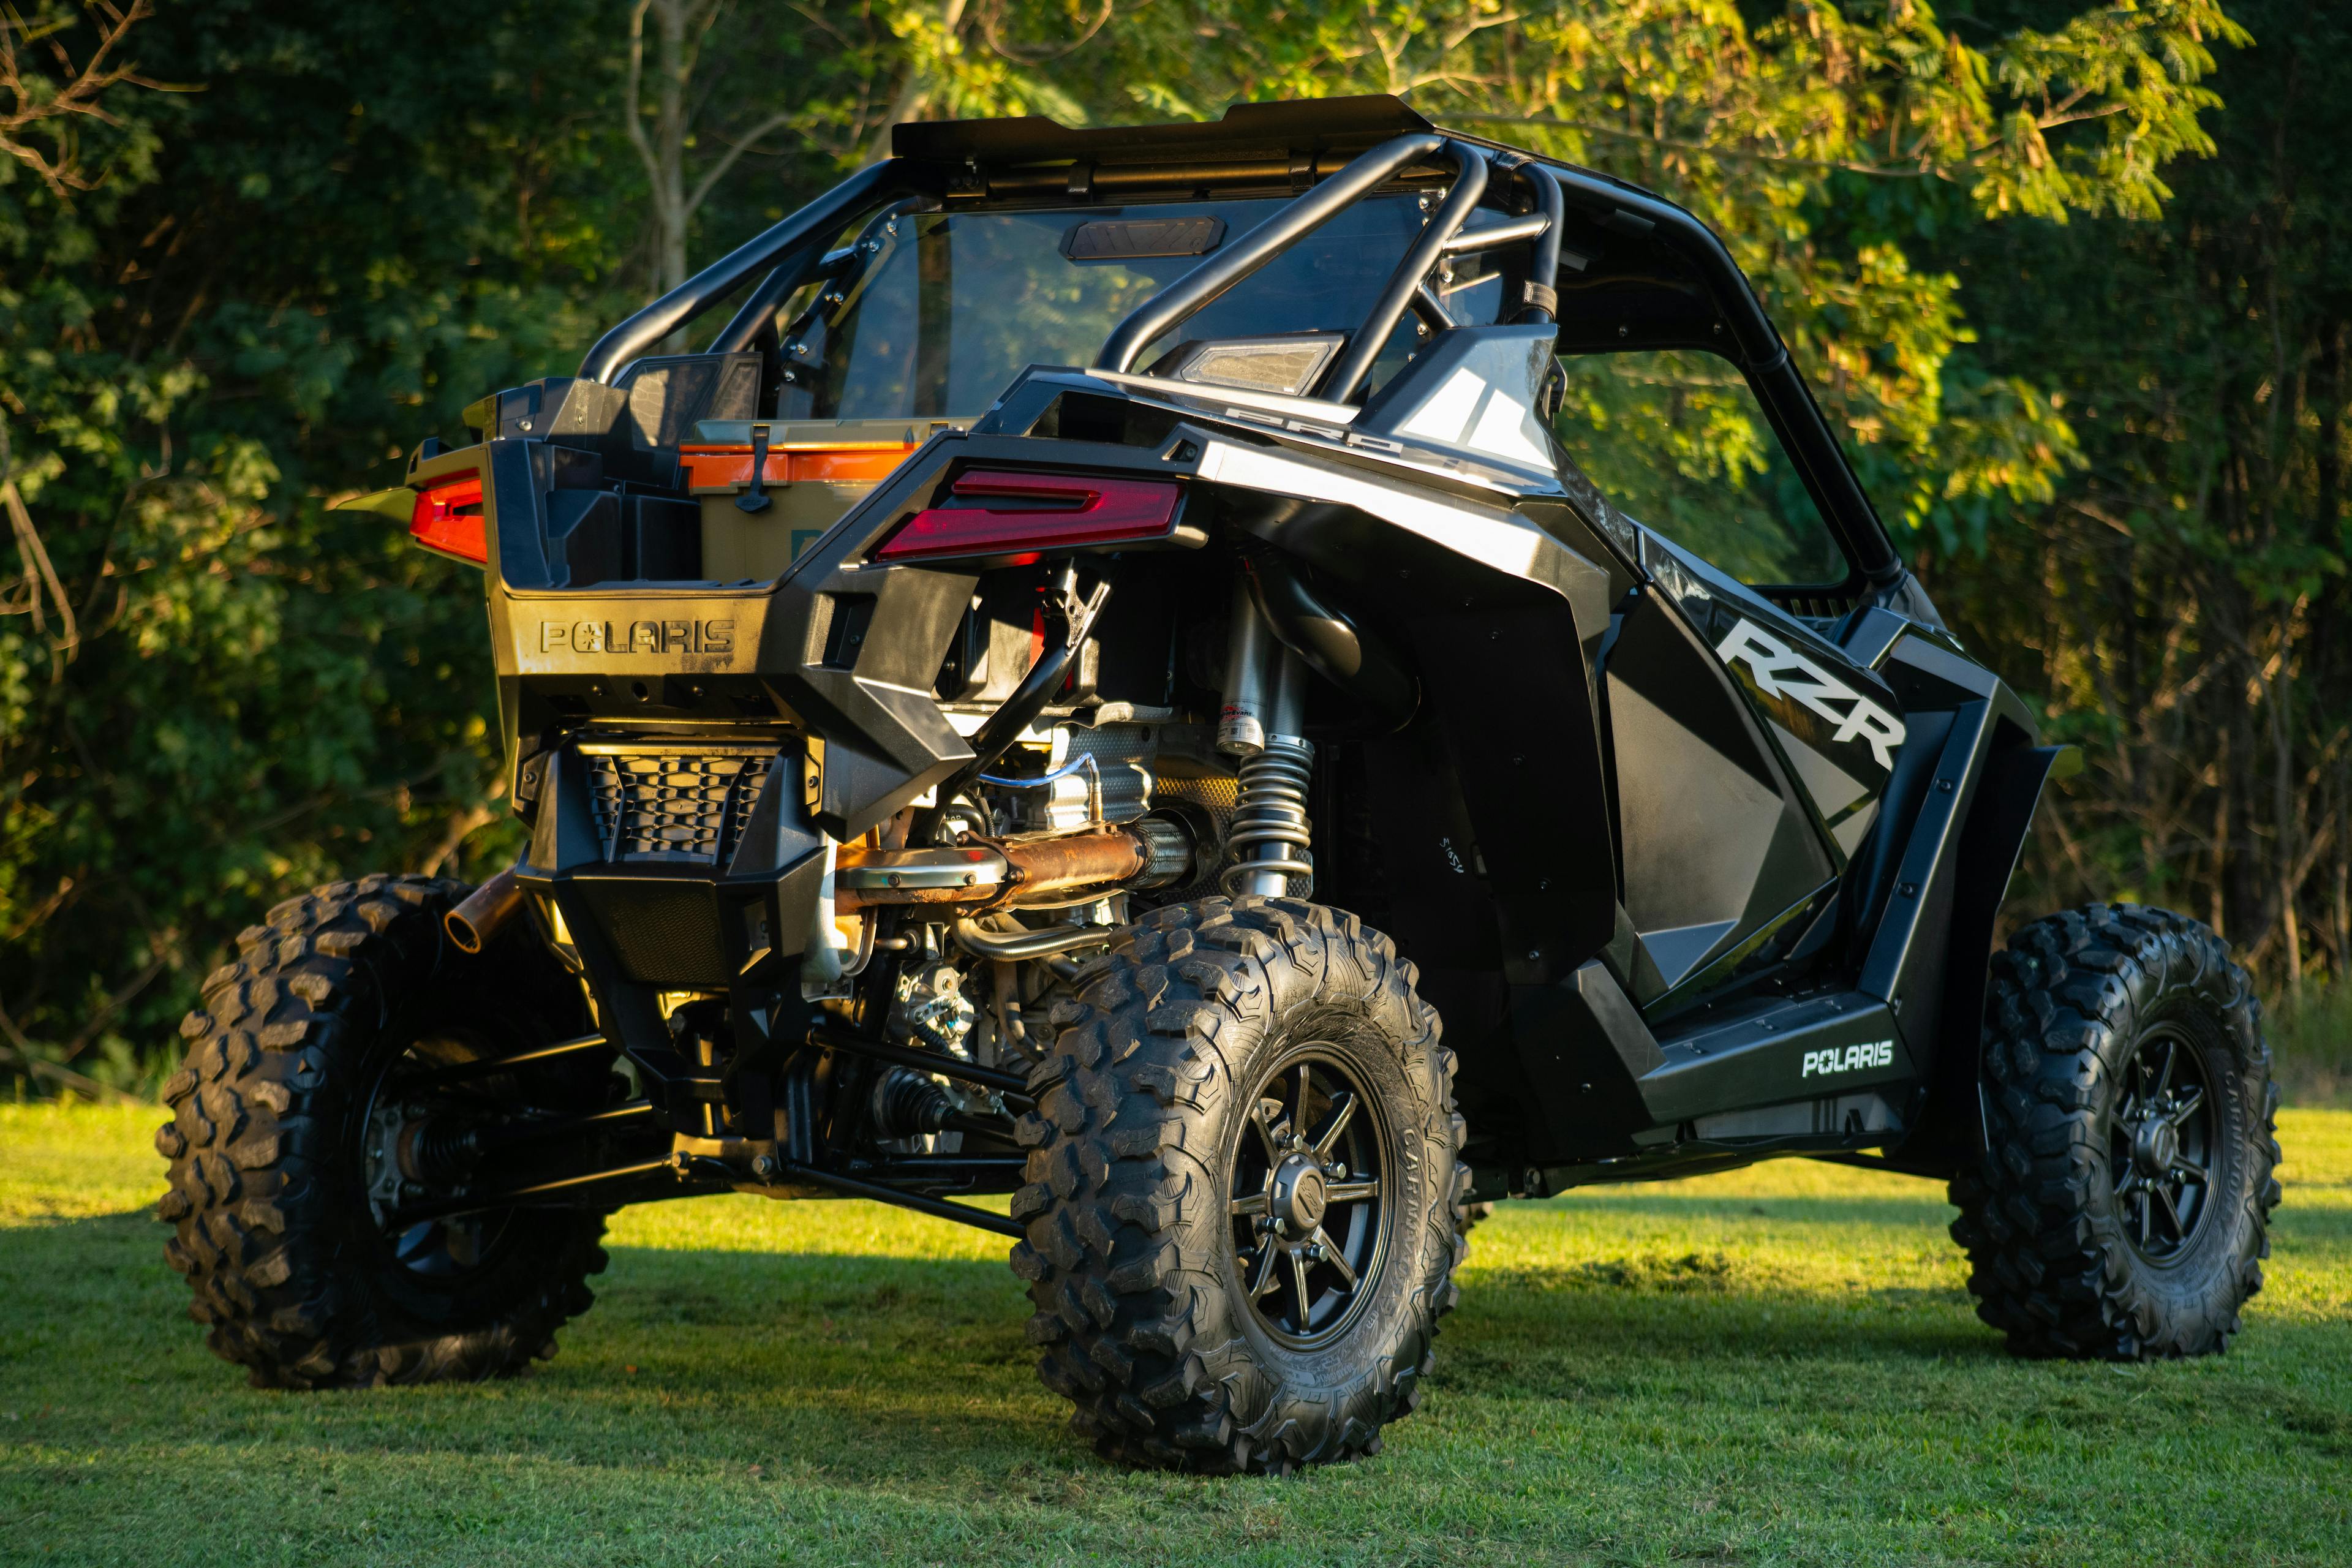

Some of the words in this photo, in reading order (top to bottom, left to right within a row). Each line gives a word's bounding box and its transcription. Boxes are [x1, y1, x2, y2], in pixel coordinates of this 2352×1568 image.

[1225, 407, 1404, 453] PRO
[540, 620, 735, 654] POLARIS
[1715, 617, 1906, 774] RZR
[1802, 1039, 1892, 1078] POLARIS
